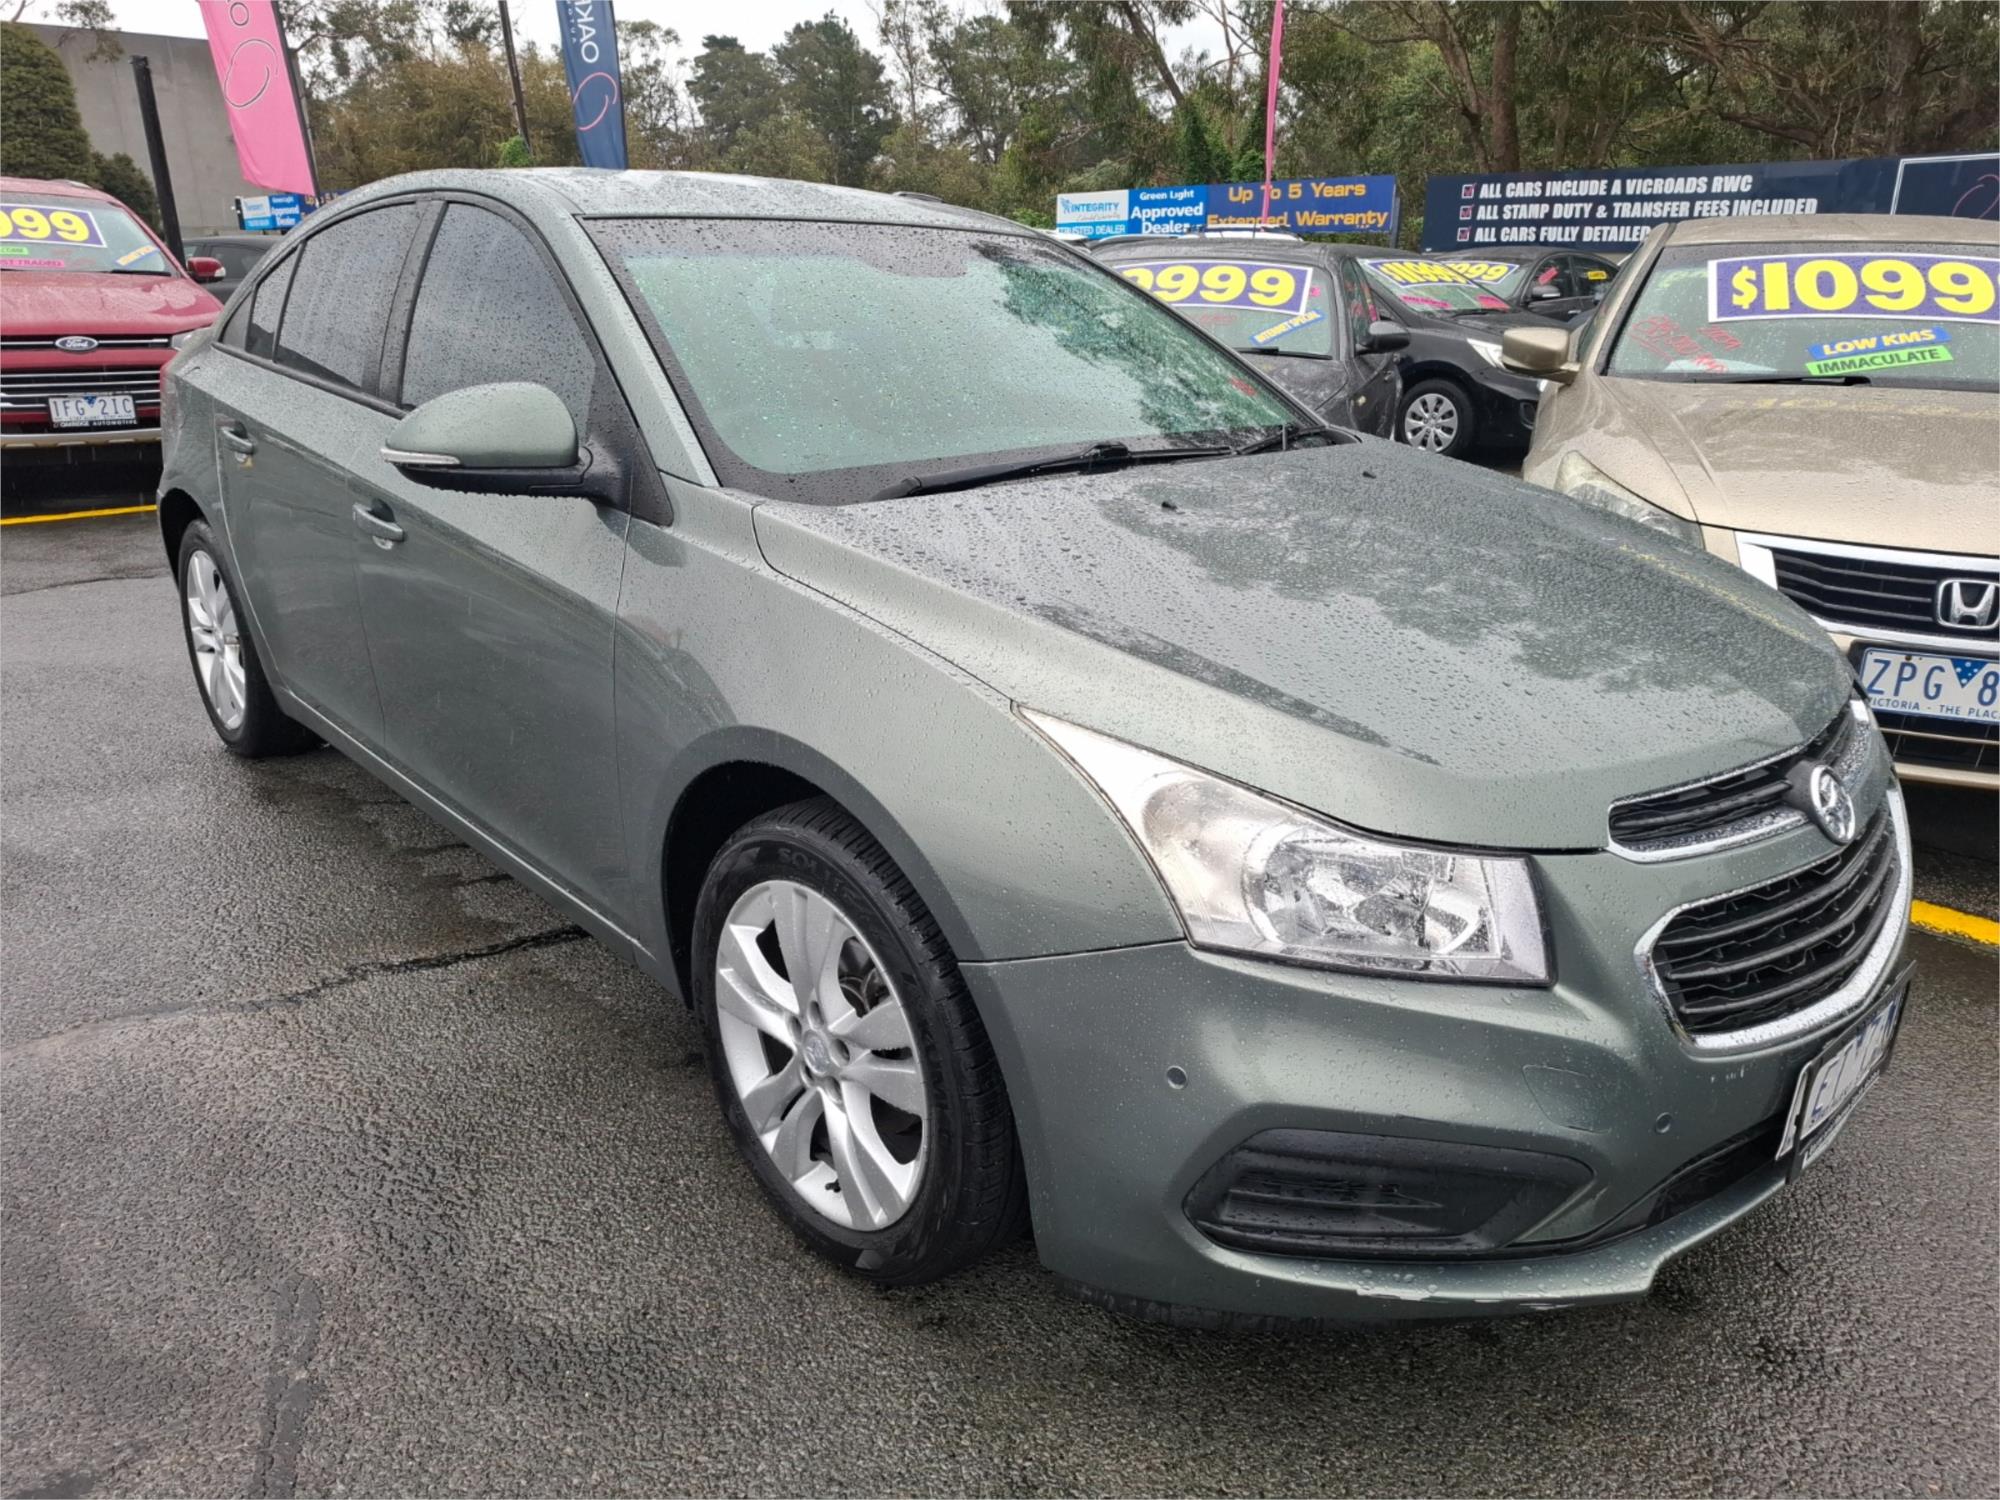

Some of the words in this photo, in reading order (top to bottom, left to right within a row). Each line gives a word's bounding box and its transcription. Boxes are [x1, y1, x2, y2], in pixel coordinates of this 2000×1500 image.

[1139, 191, 1167, 201] Green
[1170, 189, 1195, 202] Light
[1229, 186, 1254, 204] Up
[1288, 183, 1302, 199] 5
[1311, 182, 1366, 198] Years
[1479, 184, 1502, 198] ALL
[1506, 181, 1542, 197] CARS
[1545, 179, 1608, 197] INCLUDE
[1611, 179, 1622, 195] A
[1626, 176, 1709, 195] VICROADS
[1711, 174, 1754, 193] RWC
[1071, 201, 1120, 213] INTEGRITY
[1130, 201, 1204, 222] Approved
[1476, 205, 1498, 220] ALL
[1503, 203, 1550, 220] STAMP
[1552, 203, 1593, 219] DUTY
[1596, 205, 1607, 219] &
[1613, 201, 1690, 218] TRANSFER
[1693, 199, 1730, 217] FEES
[1732, 198, 1818, 216] INCLUDED
[1095, 223, 1126, 235] DEALER
[1142, 220, 1190, 235] Dealer
[1296, 209, 1388, 228] Warranty
[1474, 227, 1497, 242] ALL
[1500, 226, 1537, 242] CARS
[1540, 226, 1579, 242] FULLY
[1731, 258, 2000, 315] $1099
[1823, 337, 1877, 356] LOW
[1881, 329, 1936, 347] KMS
[1817, 347, 1941, 375] IMMACULATE
[1866, 658, 1946, 701] ZPG
[1939, 704, 1961, 716] THE
[1968, 707, 2000, 720] PLAC
